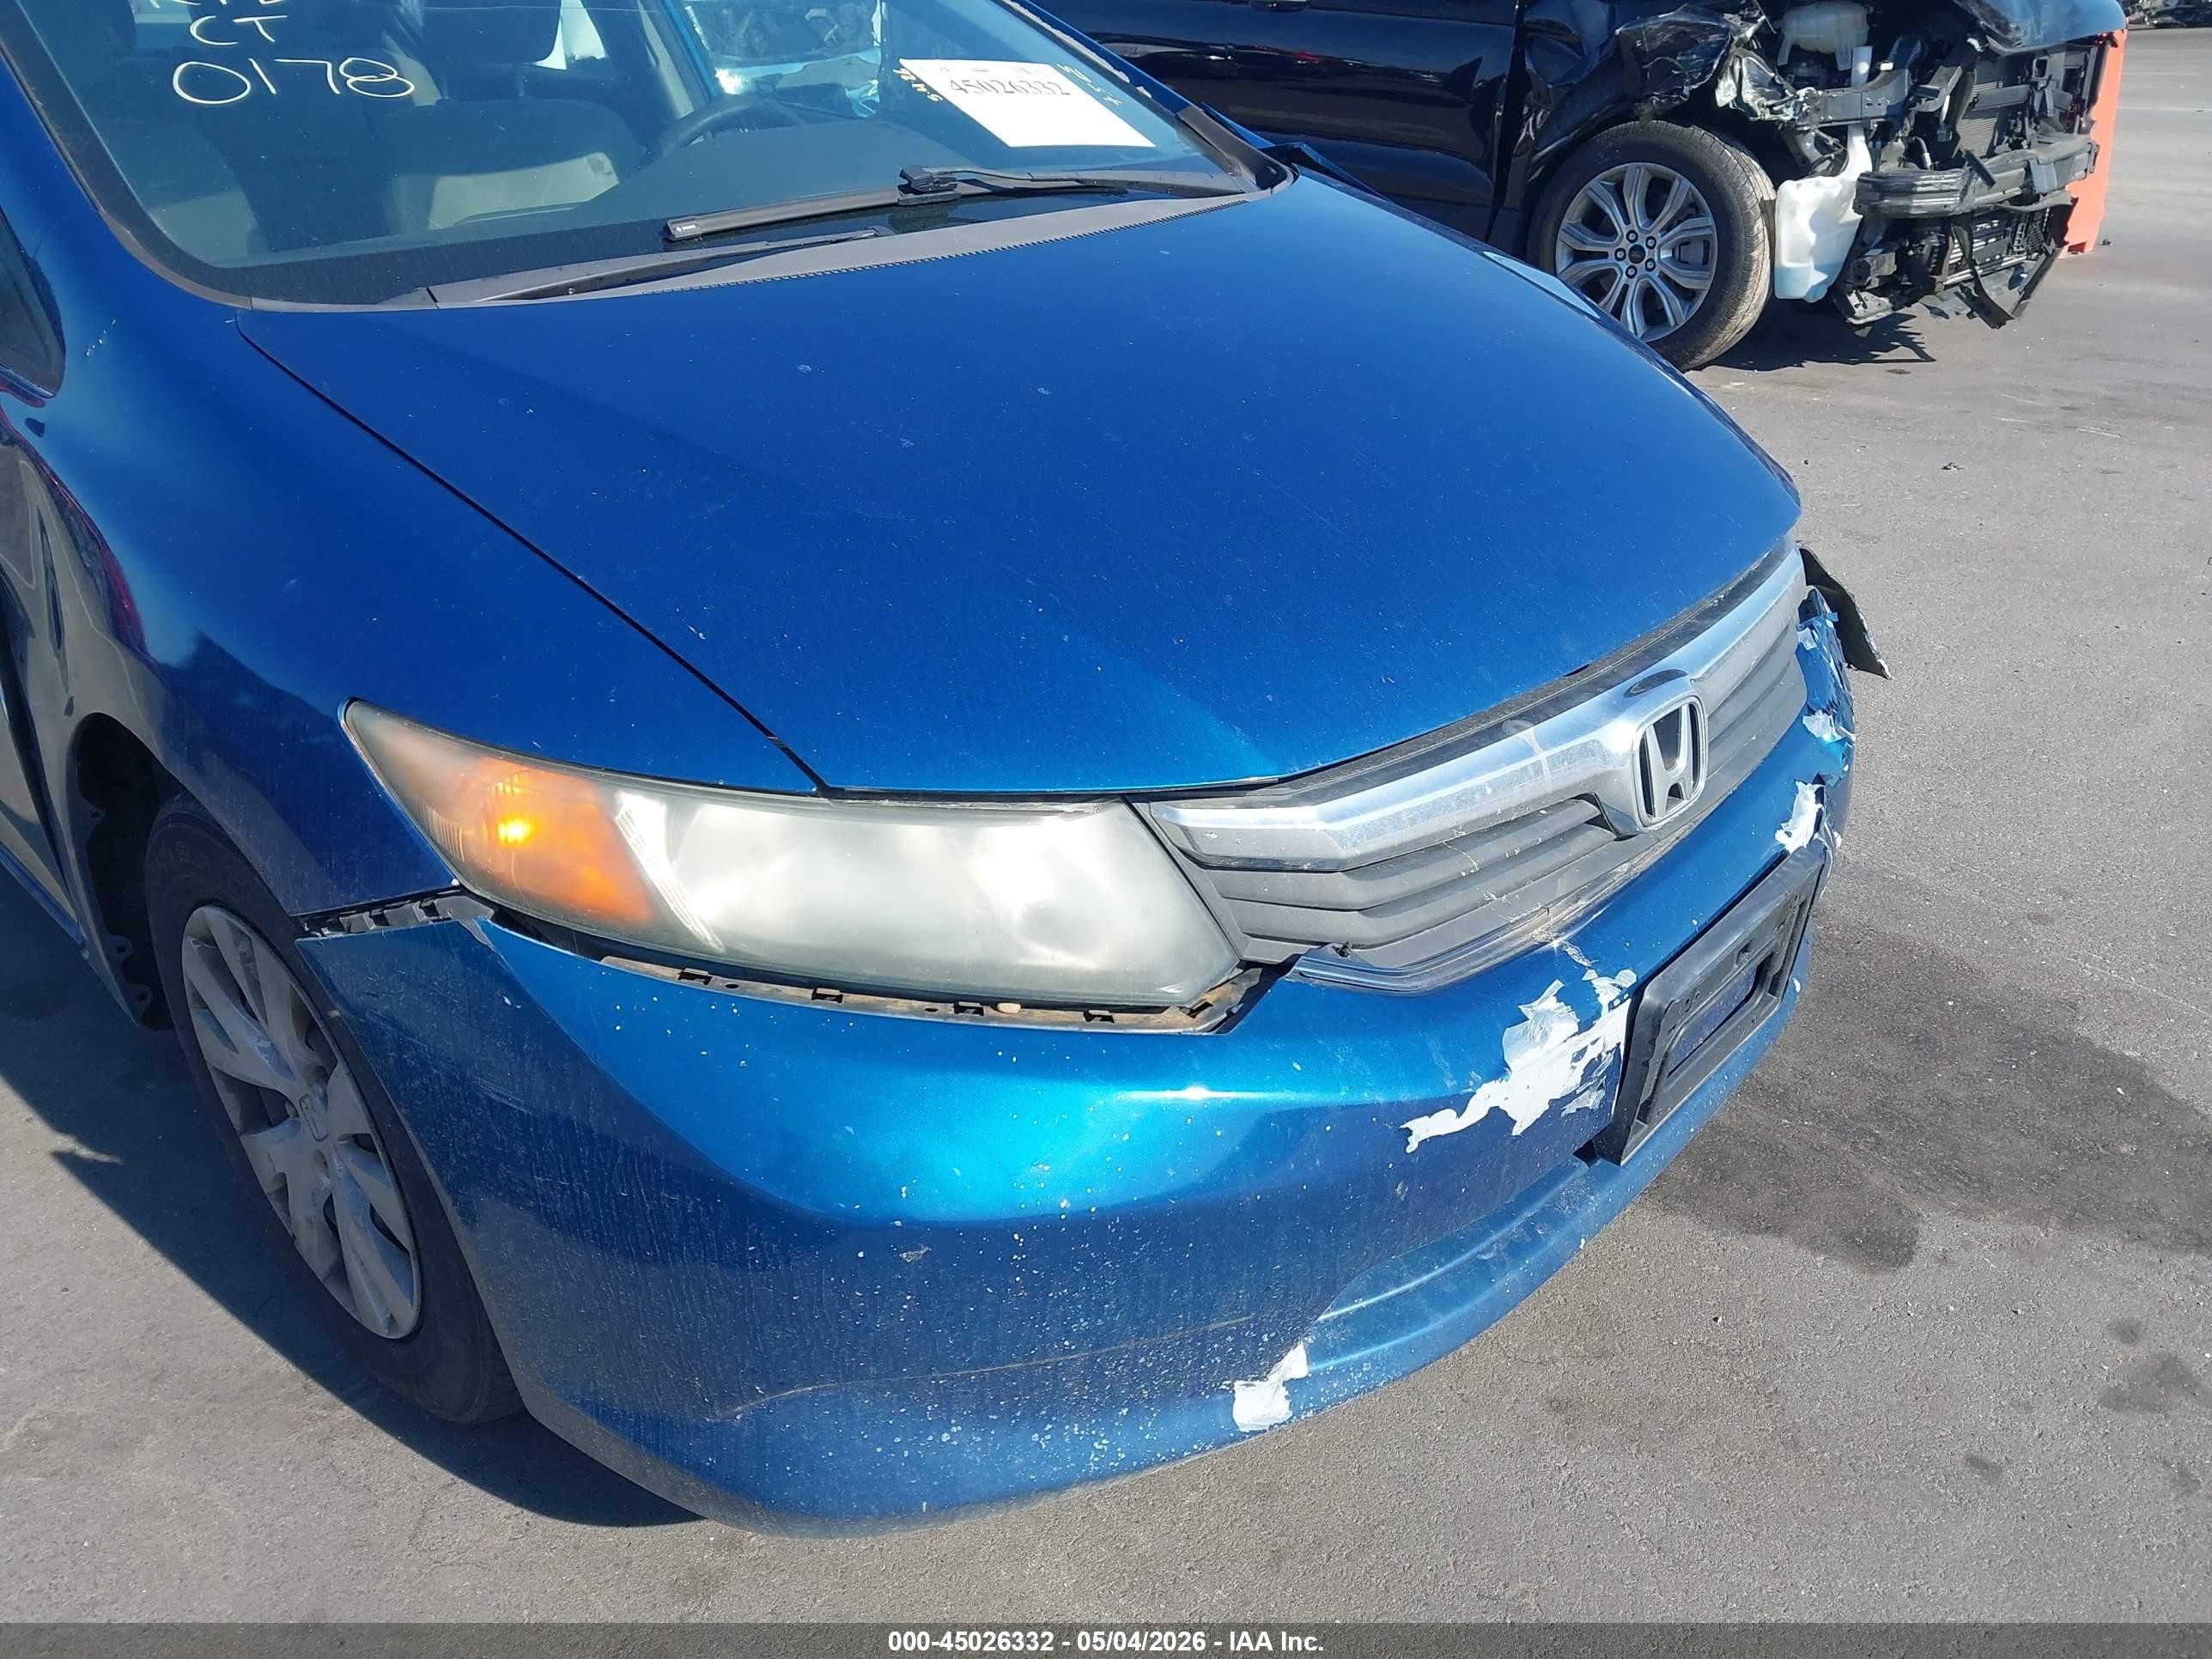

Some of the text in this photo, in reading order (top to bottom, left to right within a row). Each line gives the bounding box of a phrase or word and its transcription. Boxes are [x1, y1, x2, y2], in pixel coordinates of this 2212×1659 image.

[190, 15, 288, 46] CT
[173, 57, 416, 105] 0178
[951, 79, 1071, 95] 45026332
